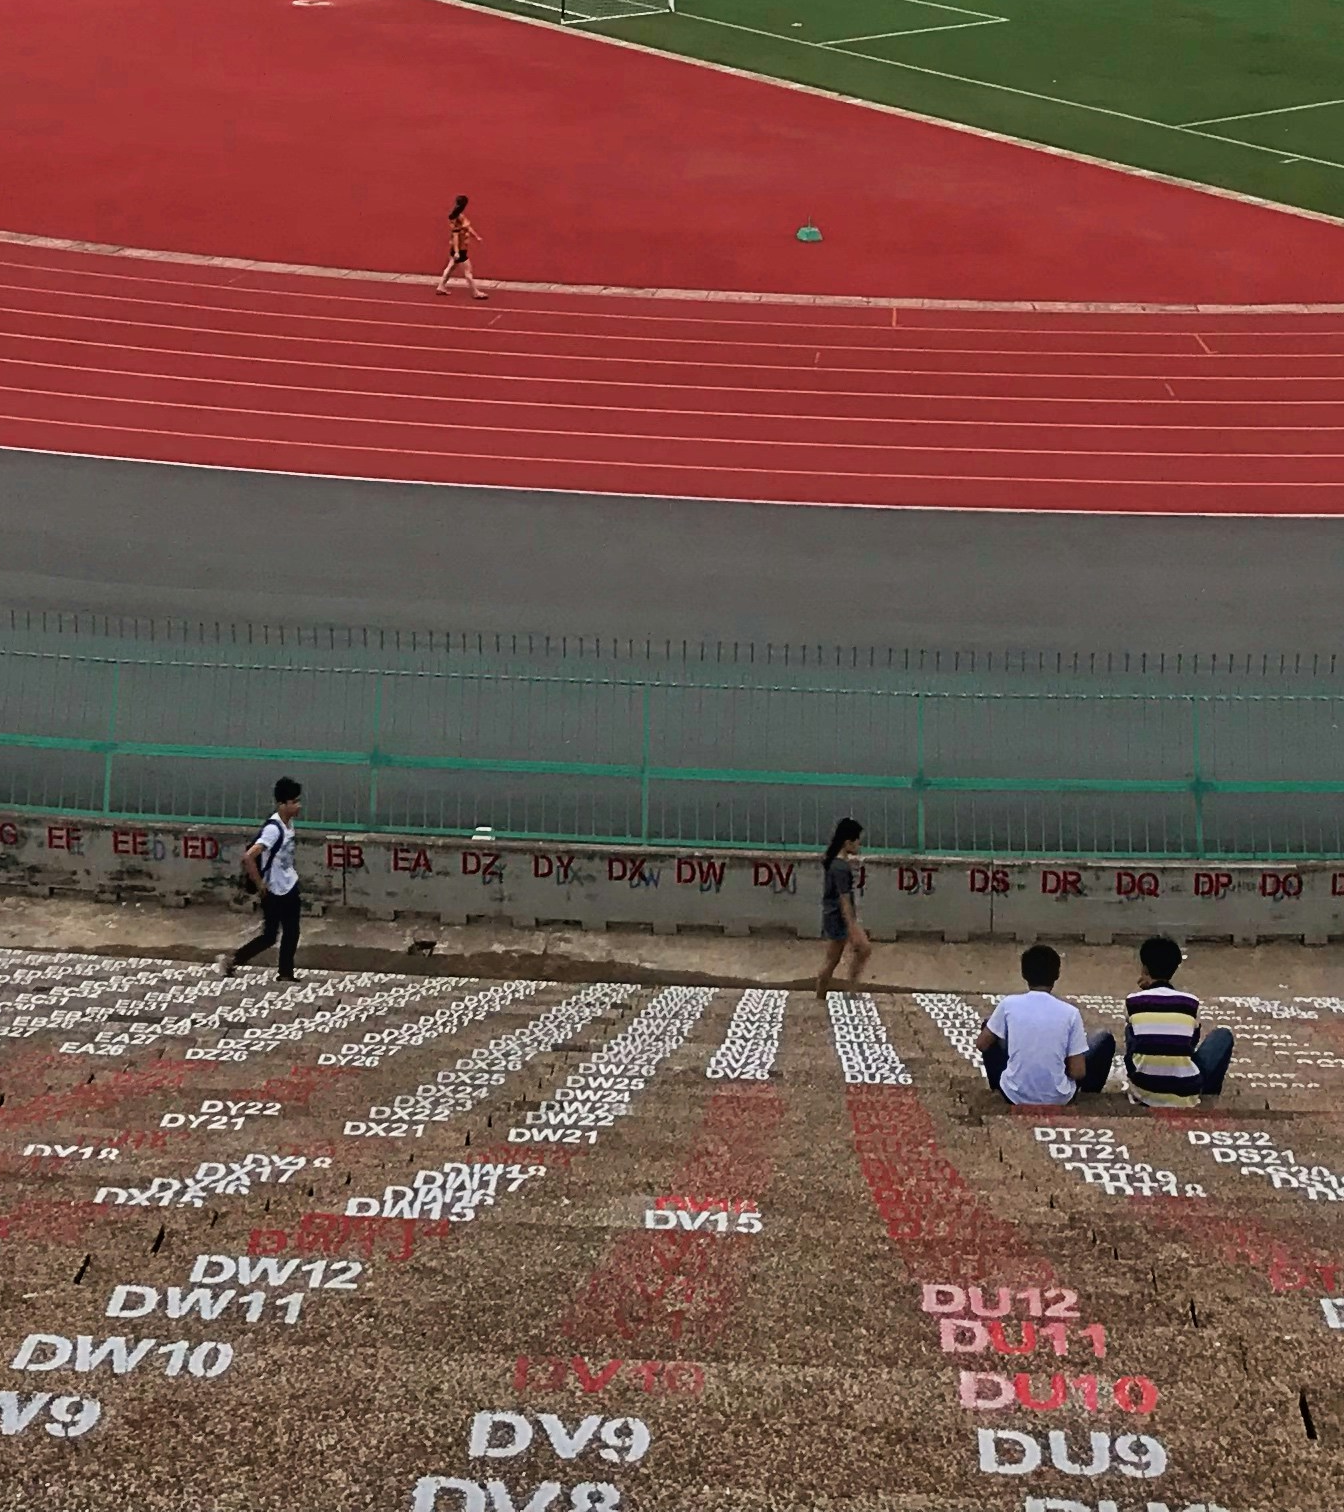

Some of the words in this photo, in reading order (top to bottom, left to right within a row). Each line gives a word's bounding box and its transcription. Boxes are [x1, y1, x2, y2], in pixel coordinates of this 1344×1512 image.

[47, 826, 82, 849] EF
[113, 831, 150, 855] EE
[183, 836, 219, 859] ED
[326, 843, 364, 869] EB
[392, 848, 433, 873] EA
[462, 852, 502, 877] DZ
[534, 855, 575, 879] DY
[607, 856, 647, 882] DX
[676, 859, 725, 885] DW
[753, 862, 794, 888] DV
[898, 867, 939, 892] DT
[969, 868, 1010, 893] DS
[1041, 870, 1081, 894] DR
[1116, 871, 1159, 897] DQ
[1194, 872, 1233, 896] DP
[1261, 872, 1303, 897] DO
[95, 1031, 161, 1044] EA27
[216, 1038, 280, 1052] DZ27
[59, 1042, 125, 1056] EA26
[185, 1049, 248, 1062] DZ26
[341, 1044, 404, 1057] DY27
[317, 1053, 380, 1068] DY26
[455, 1059, 522, 1071] DX26
[578, 1063, 655, 1077] DW26
[707, 1067, 770, 1080] DV26
[437, 1071, 506, 1085] DX25
[566, 1076, 645, 1090] DW25
[845, 1072, 913, 1085] DU26
[416, 1085, 490, 1099] DX24
[555, 1089, 630, 1103] DW24
[200, 1100, 282, 1115] DY22
[369, 1107, 450, 1122] DX22
[160, 1113, 247, 1131] DY21
[526, 1112, 615, 1125] DW22
[343, 1122, 425, 1137] DX21
[508, 1128, 597, 1144] DW21
[1033, 1127, 1115, 1143] DT22
[1188, 1130, 1273, 1145] DS22
[1048, 1143, 1130, 1160] DT21
[1211, 1147, 1295, 1163] DS21
[644, 1210, 763, 1233] DV15
[188, 1255, 362, 1289] DW12
[105, 1286, 306, 1324] DW11
[922, 1283, 1082, 1318] DU12
[939, 1318, 1109, 1357] DU11
[9, 1334, 233, 1378] DW10
[958, 1370, 1158, 1414] DU10
[467, 1409, 652, 1462] DV9
[977, 1428, 1170, 1477] DU9
